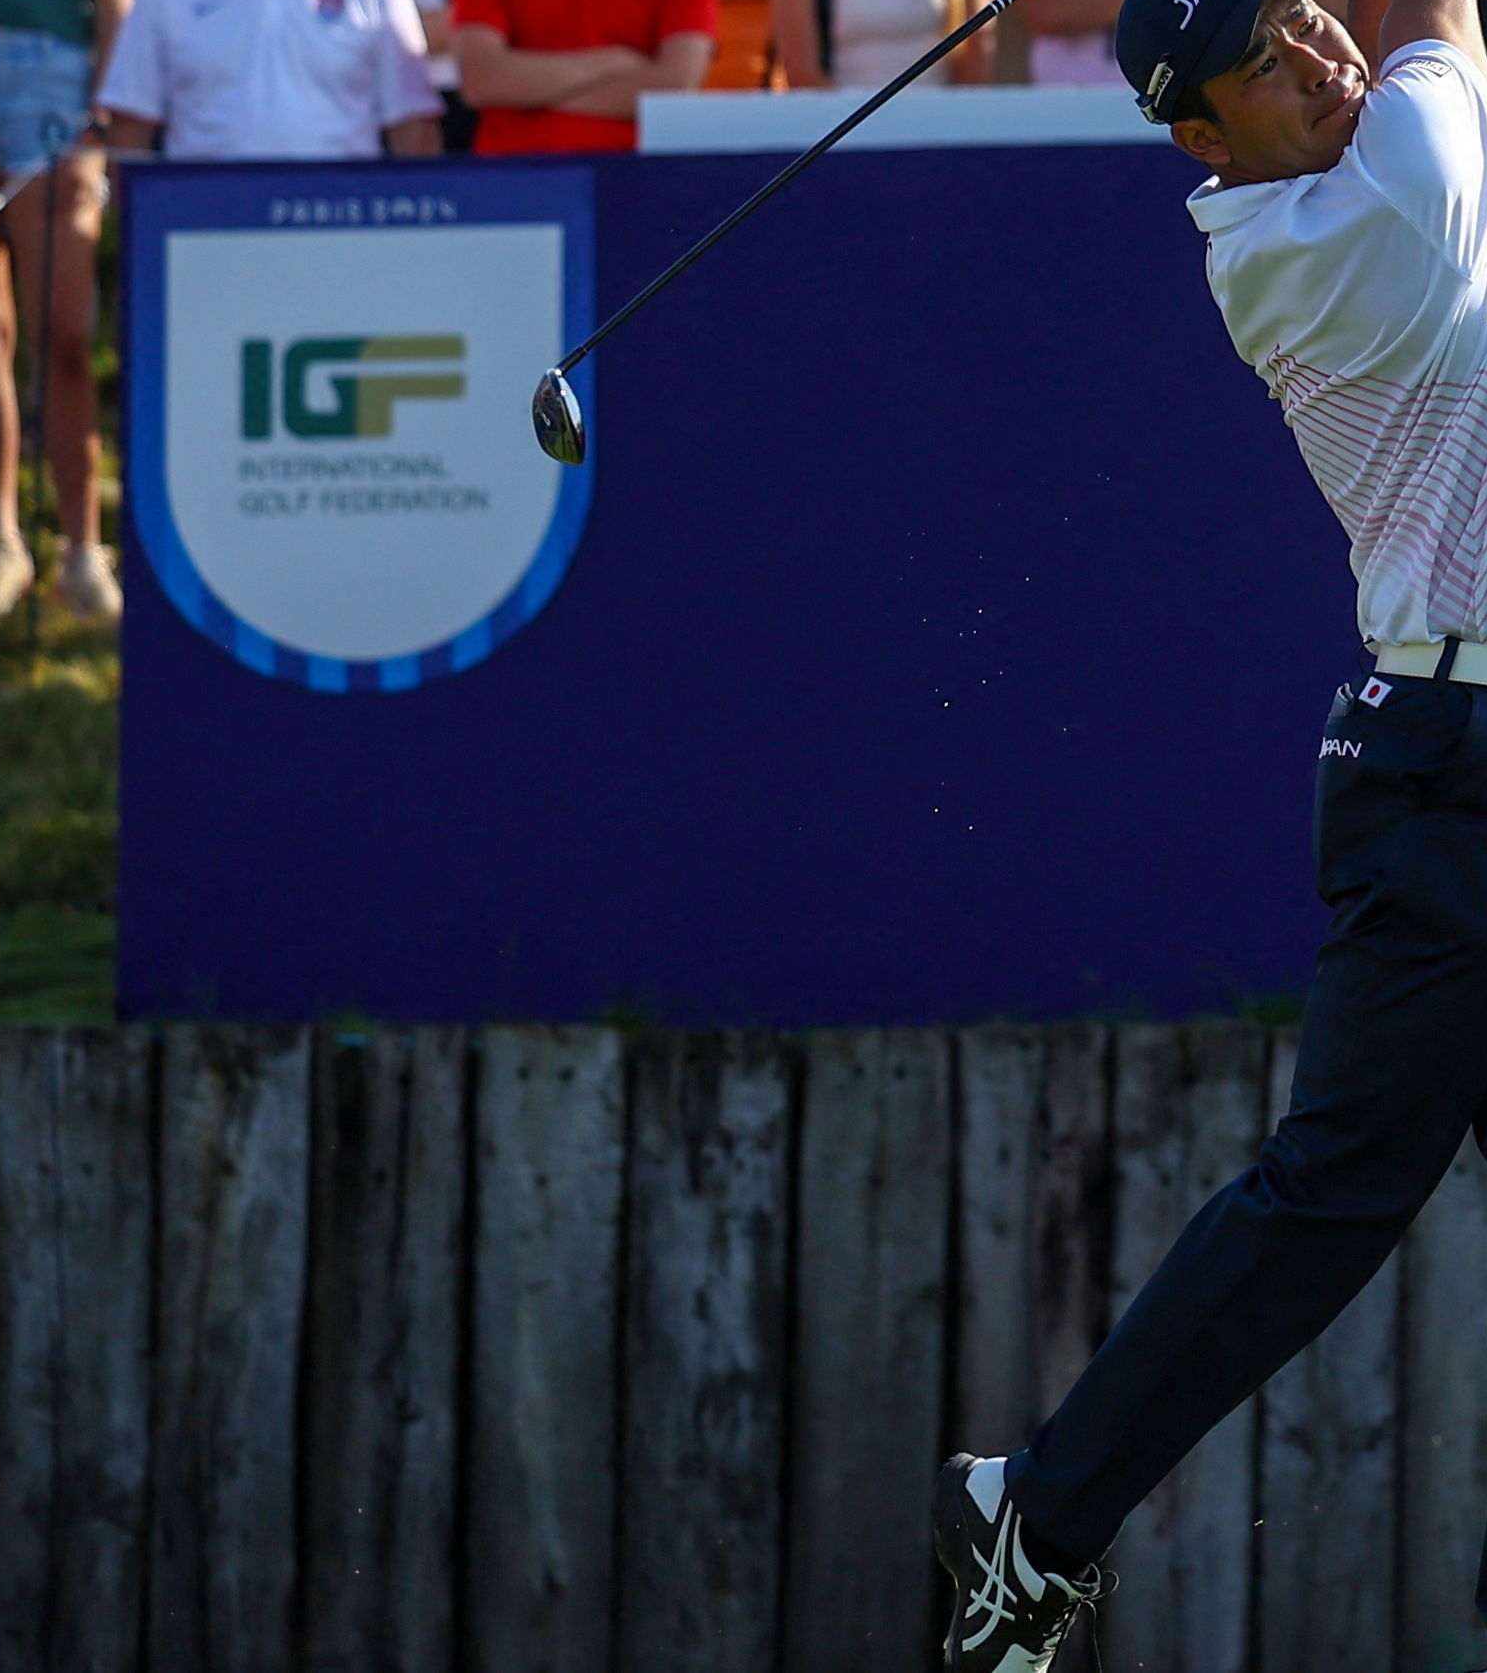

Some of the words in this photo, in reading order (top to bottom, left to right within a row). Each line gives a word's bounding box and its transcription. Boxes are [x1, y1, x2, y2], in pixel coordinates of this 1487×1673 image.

[271, 197, 363, 224] PARIS
[241, 336, 467, 442] IGF
[239, 453, 449, 479] INTERNATIONAL
[239, 488, 309, 514] GOLF
[320, 485, 490, 511] FEDERATION
